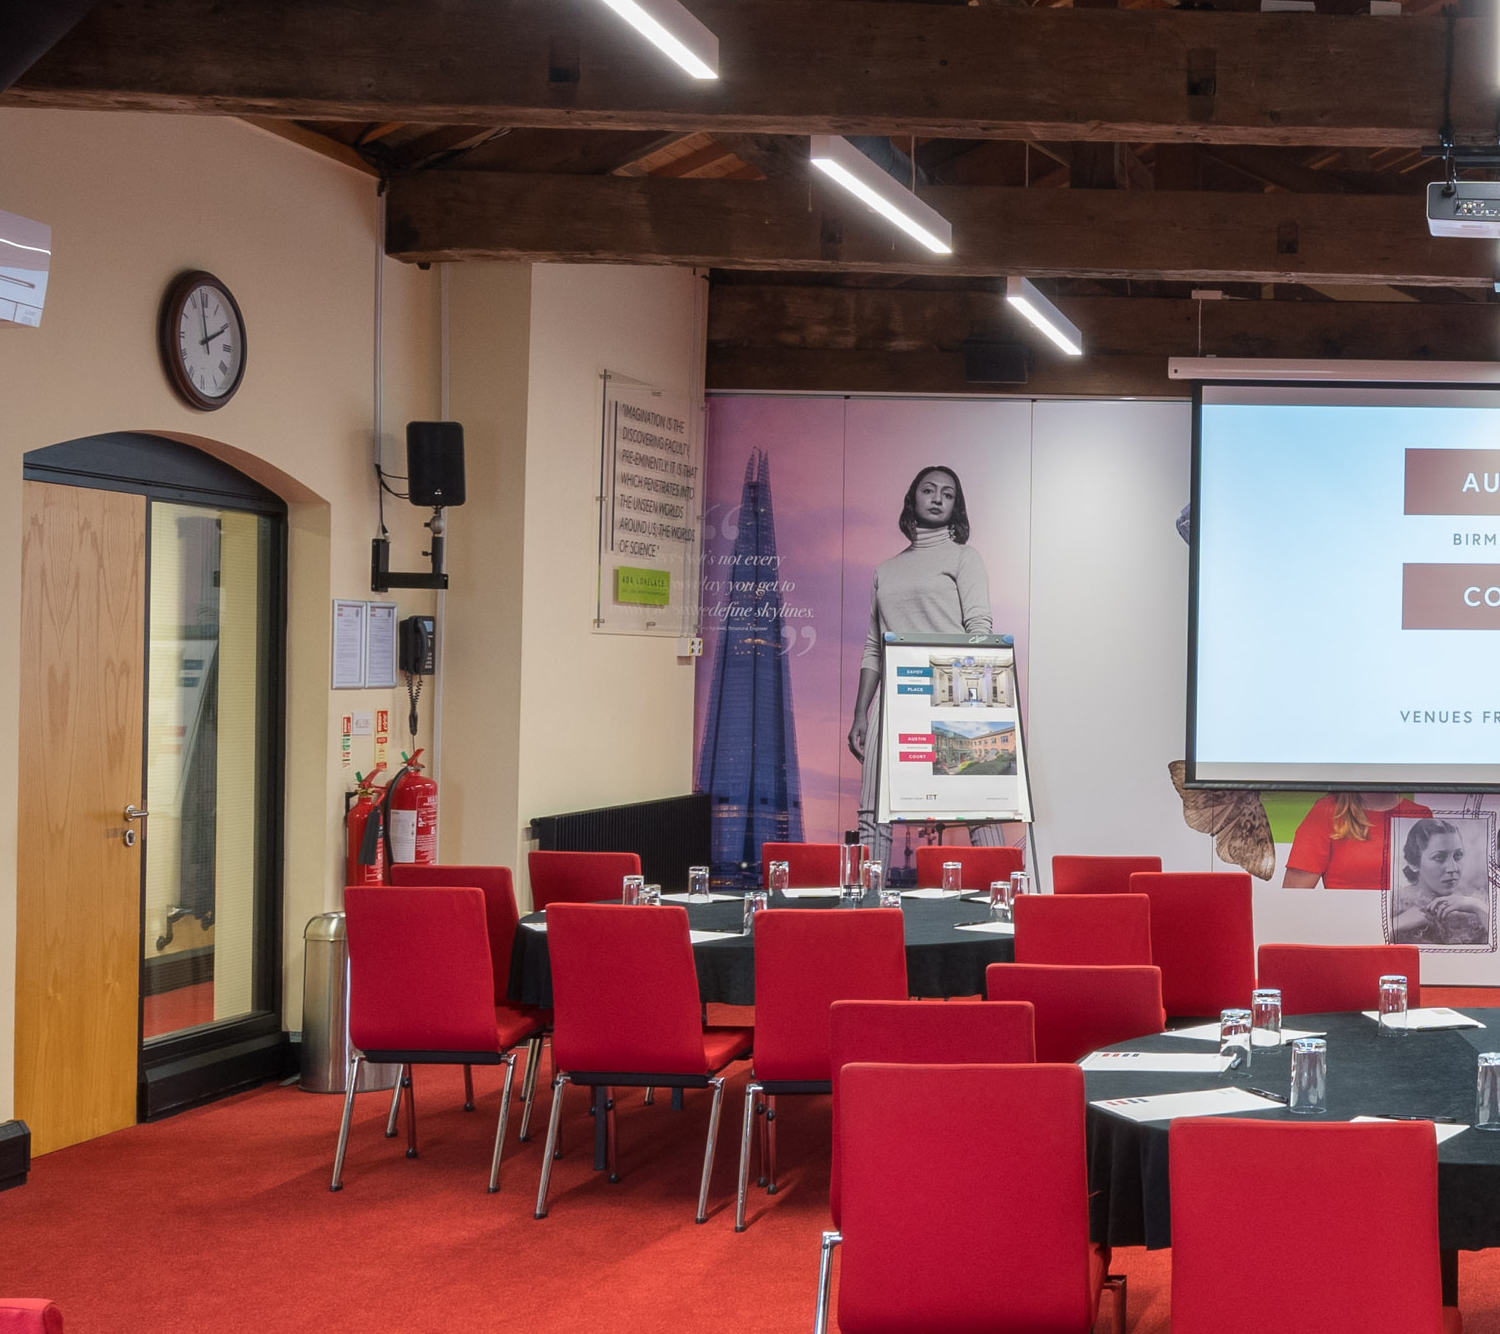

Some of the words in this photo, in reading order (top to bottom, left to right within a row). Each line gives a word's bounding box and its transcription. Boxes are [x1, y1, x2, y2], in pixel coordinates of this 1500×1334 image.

[718, 554, 743, 566] not
[744, 555, 786, 571] every
[724, 580, 755, 596] you
[755, 580, 779, 597] get
[781, 580, 796, 592] to
[754, 601, 815, 623] skylines.
[1400, 710, 1474, 725] VENUES
